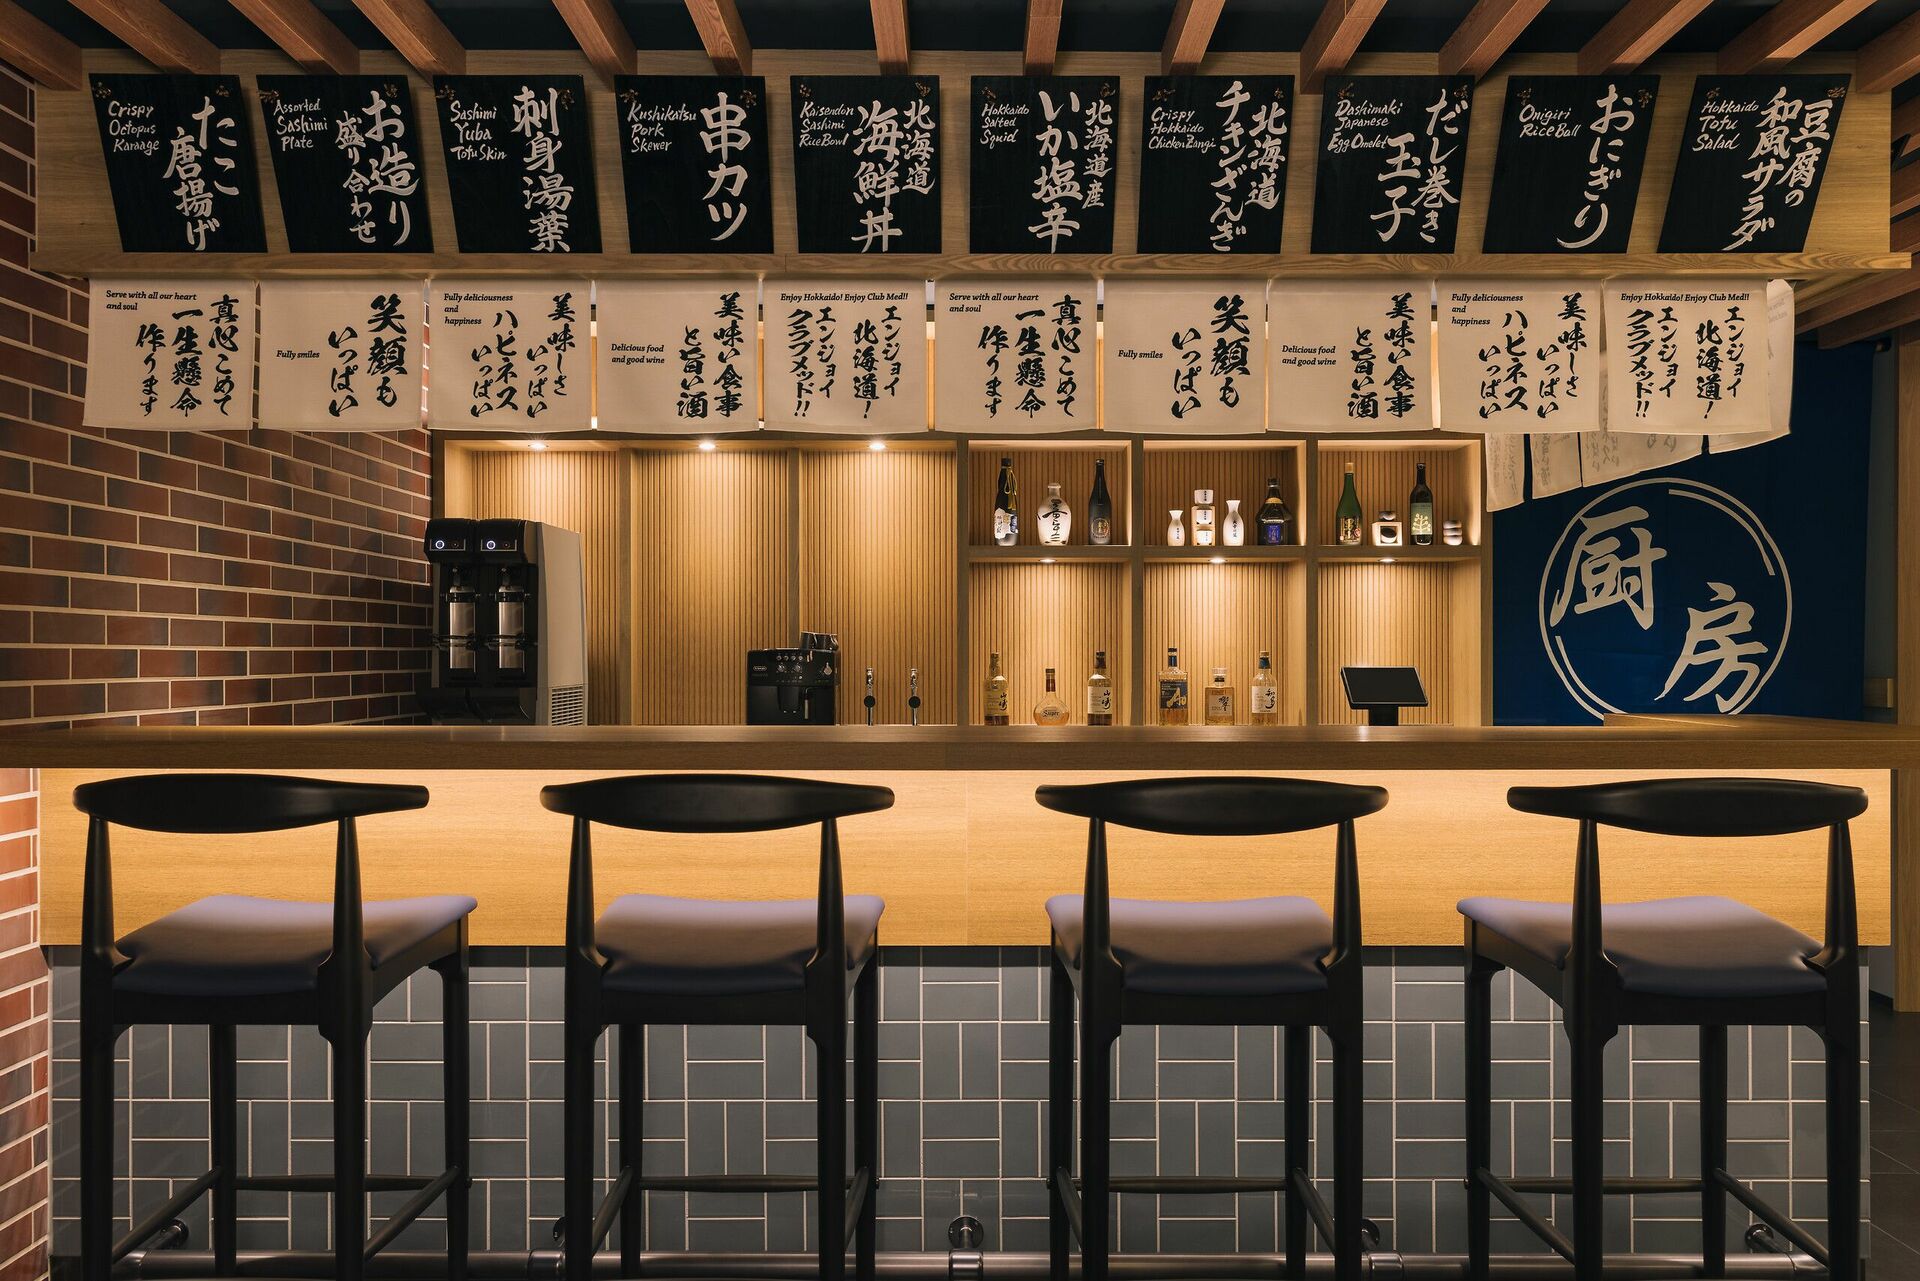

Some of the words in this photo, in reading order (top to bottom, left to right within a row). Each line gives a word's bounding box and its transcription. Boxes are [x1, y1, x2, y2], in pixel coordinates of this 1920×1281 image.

[108, 101, 154, 118] Crispy
[109, 119, 156, 137] Octopus
[274, 98, 321, 113] Assorted
[277, 115, 328, 135] Sashimi
[450, 101, 497, 122] Sashimi
[455, 122, 492, 142] Yuba
[628, 103, 697, 122] Kushikatsu
[632, 123, 664, 139] Pork
[799, 134, 822, 148] Rice
[822, 133, 848, 146] Bowl
[800, 102, 854, 118] Kaisendon
[802, 119, 845, 132] Sashimi
[980, 129, 1018, 144] Squid
[981, 104, 1029, 117] Hokkaido
[982, 116, 1016, 128] Salted
[1151, 107, 1195, 122] Crispy
[1151, 123, 1204, 134] Hokkaido
[1336, 100, 1403, 118] Dashimaki
[1336, 116, 1389, 129] Japanese
[1519, 104, 1570, 125] Onigiri
[1519, 123, 1554, 138] Rice
[1555, 123, 1581, 138] Ball
[1692, 133, 1741, 151] Salad
[1699, 115, 1738, 131] Tofu
[1702, 101, 1758, 113] Hokkaido
[113, 138, 159, 155] Karaage
[192, 96, 239, 195] たこ
[281, 136, 313, 150] Plate
[334, 111, 376, 243] 盛り合わせ
[362, 90, 419, 246] お造り
[451, 146, 479, 161] Tofu
[479, 145, 507, 161] Skin
[511, 86, 574, 252] 刺身湯葉
[631, 137, 672, 152] Skewer
[700, 91, 751, 241] 串カツ
[851, 100, 904, 253] 海鮮丼
[901, 99, 936, 195] 北海道
[1028, 90, 1083, 254] いか塩辛
[1082, 99, 1112, 209] 北海道産
[1148, 137, 1187, 150] Chicken
[1185, 134, 1216, 153] Zangi
[1209, 81, 1250, 251] チキンざんぎ
[1245, 102, 1288, 209] 北海道
[1328, 132, 1351, 154] Egg
[1351, 133, 1388, 149] Omelet
[1411, 89, 1468, 243] だし巻き
[1556, 84, 1635, 249] おにぎり
[1721, 86, 1802, 251] 和風サラダ
[1775, 99, 1832, 207] 豆腐の
[162, 126, 220, 250] 唐揚げ
[1370, 132, 1421, 242] 玉子
[106, 290, 128, 298] Serve
[128, 290, 146, 298] with
[148, 292, 158, 300] all
[174, 292, 196, 300] heart
[106, 302, 122, 310] and
[122, 302, 138, 310] soul
[444, 292, 462, 304] Fully
[464, 294, 514, 302] deliciousness
[444, 304, 458, 312] and
[444, 316, 482, 326] happiness
[780, 294, 802, 304] Enjoy
[804, 292, 844, 300] Hokkaido!
[844, 294, 866, 304] Enjoy
[868, 292, 884, 300] Club
[886, 292, 908, 300] Med!!
[950, 292, 970, 300] Serve
[972, 292, 990, 300] with
[992, 292, 1002, 300] all
[1018, 292, 1040, 300] heart
[950, 304, 964, 312] and
[964, 304, 982, 312] soul
[1452, 294, 1472, 304] Fully
[1472, 294, 1524, 302] deliciousness
[1452, 316, 1490, 326] happiness
[1620, 294, 1644, 304] Enjoy
[1644, 292, 1684, 302] Hokkaido!
[1684, 294, 1708, 304] Enjoy
[1728, 292, 1750, 300] Med!!
[136, 322, 166, 416] 作ります
[170, 308, 204, 418] 一生懸命
[208, 294, 240, 416] 真心こめて
[276, 350, 296, 360] Fully
[296, 350, 320, 358] smiles
[328, 326, 358, 418] いっぱい
[366, 294, 408, 408] 笑顔も
[470, 344, 494, 418] いっぱい
[492, 310, 518, 410] ハピネス
[526, 344, 548, 418] いっぱい
[546, 292, 576, 396] 美味しさ
[612, 344, 646, 352] Delicious
[646, 344, 664, 354] food
[612, 354, 626, 362] and
[626, 356, 646, 366] good
[646, 356, 664, 364] wine
[676, 326, 708, 418] と旨い酒
[712, 292, 744, 418] 美味い食事
[788, 308, 814, 416] クラブメッド!!
[816, 306, 836, 398] エンジョイ
[852, 318, 880, 418] 北海道!
[880, 306, 902, 396] エンジョイ
[978, 324, 1010, 418] 作ります
[1014, 310, 1046, 418] 一生懸命
[1052, 294, 1082, 418] 真心こめて
[1118, 350, 1138, 360] Fully
[1138, 350, 1164, 358] smiles
[1172, 328, 1202, 418] いっぱい
[1210, 294, 1250, 408] 笑顔も
[1282, 344, 1316, 354] Delicious
[1318, 346, 1336, 354] food
[1282, 356, 1296, 364] and
[1296, 358, 1316, 368] good
[1318, 358, 1336, 366] wine
[1348, 326, 1378, 420] と旨い酒
[1384, 292, 1416, 418] 美味い食事
[1478, 344, 1502, 418] いっぱい
[1502, 310, 1528, 410] ハピネス
[1536, 344, 1560, 418] いっぱい
[1558, 292, 1588, 398] 美味しさ
[1626, 308, 1654, 418] クラブメッド!!
[1658, 306, 1678, 398] エンジョイ
[1696, 320, 1724, 418] 北海道!
[1724, 306, 1744, 398] エンジョイ
[1550, 506, 1768, 713] 厨房
